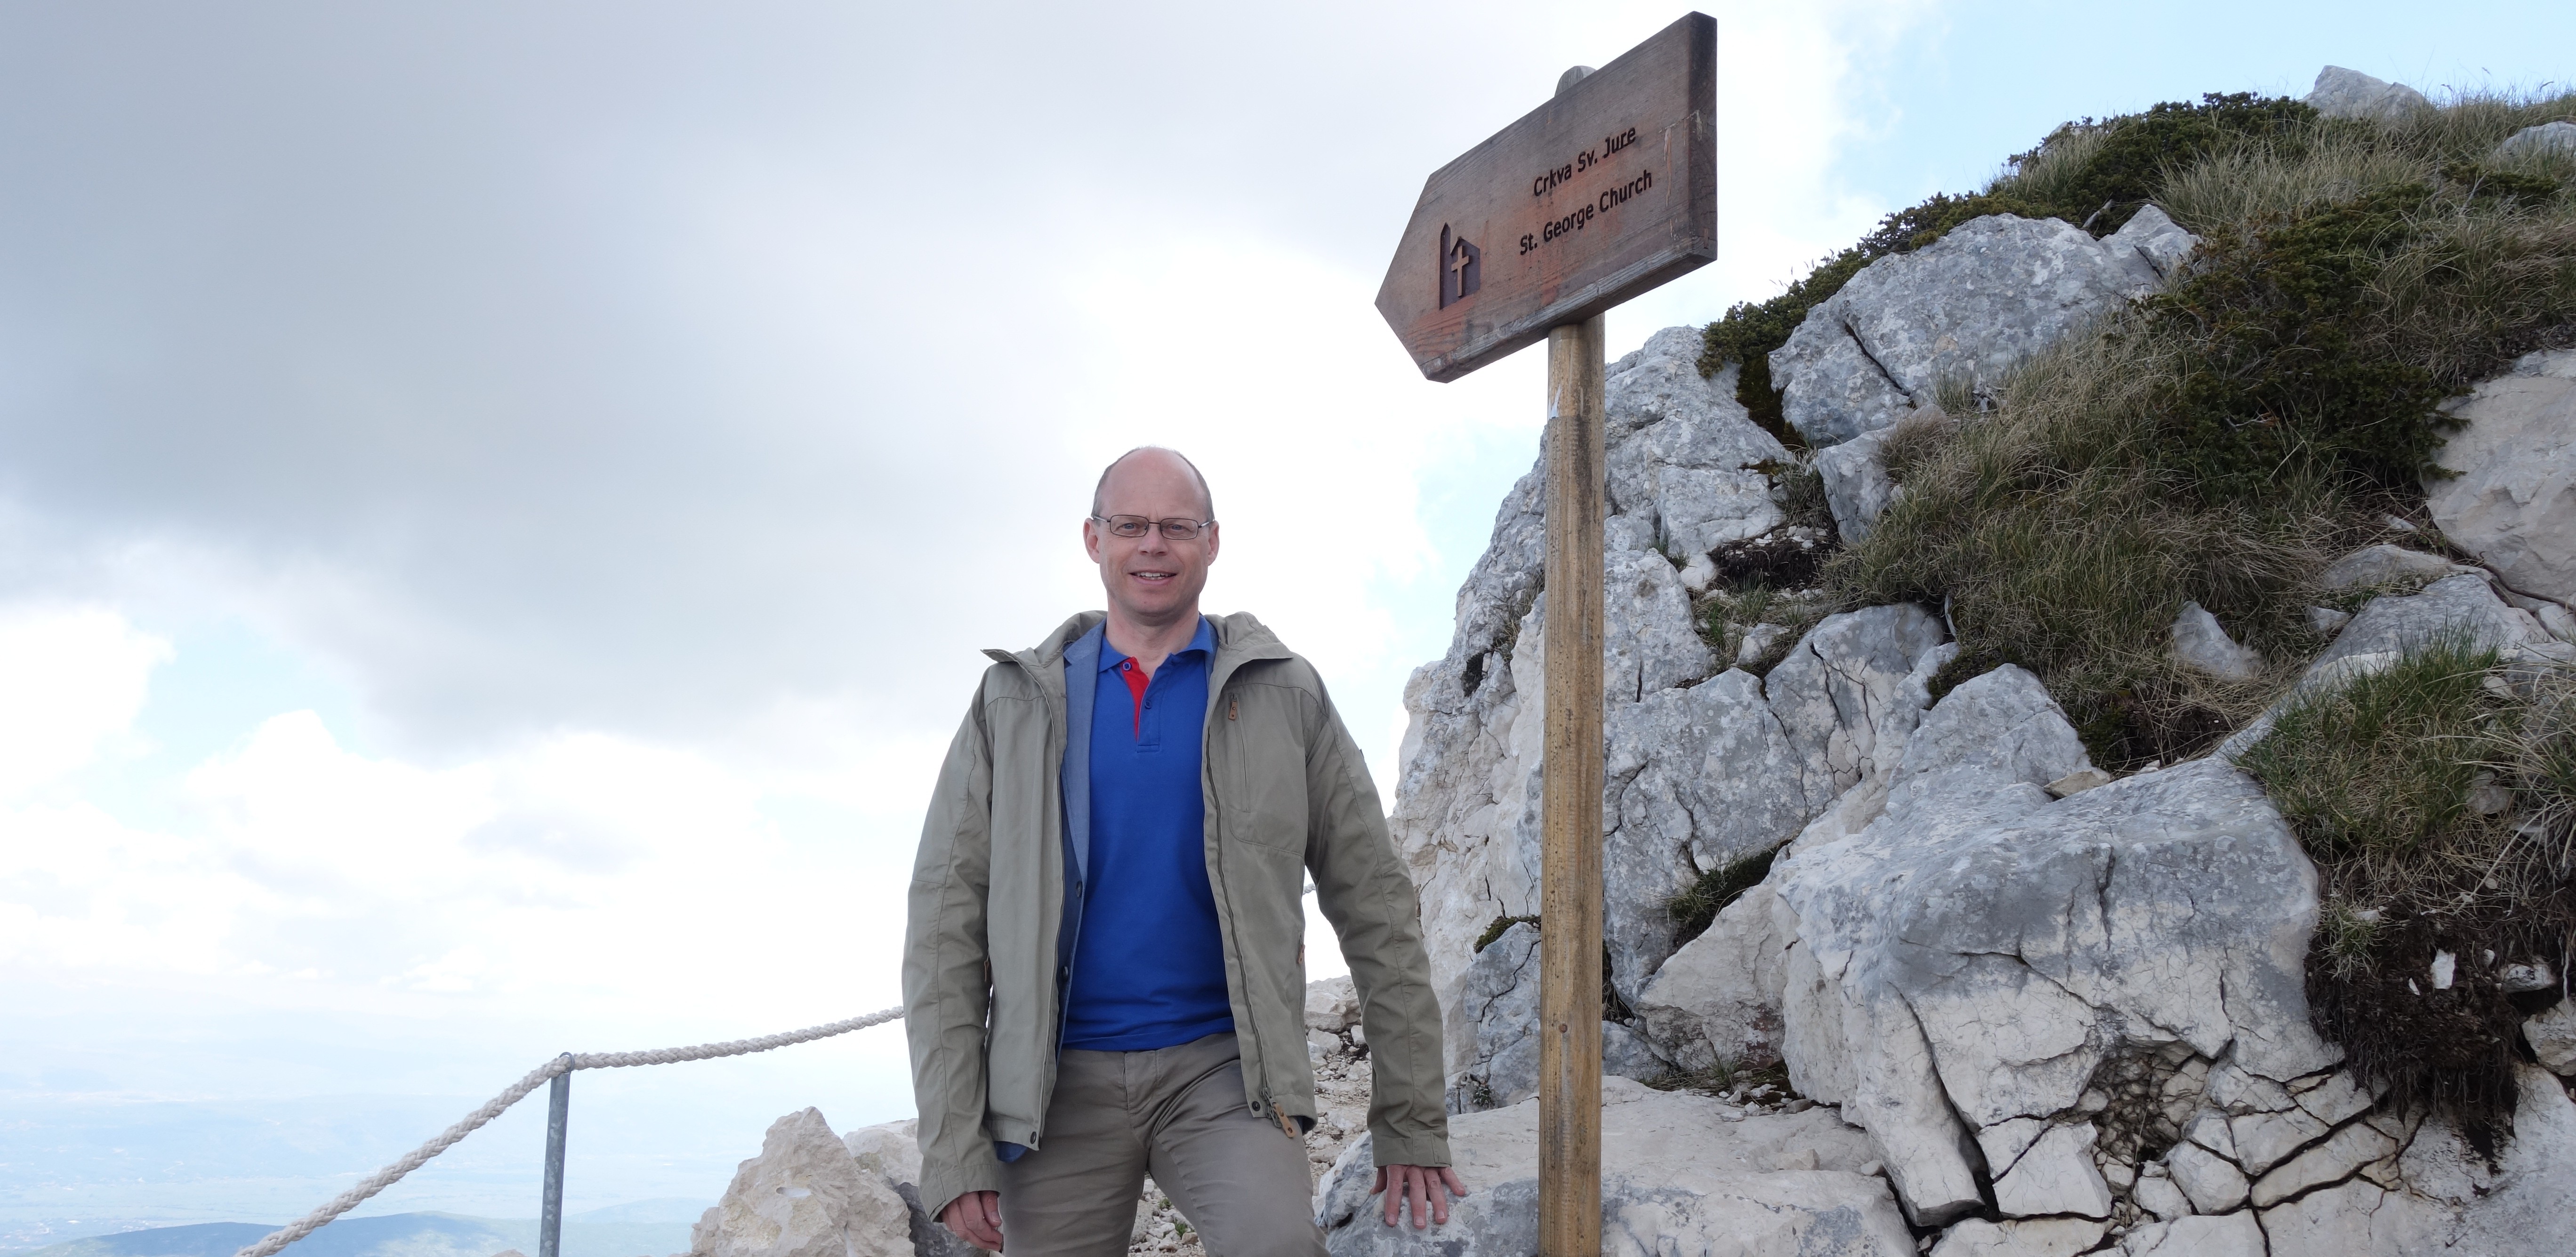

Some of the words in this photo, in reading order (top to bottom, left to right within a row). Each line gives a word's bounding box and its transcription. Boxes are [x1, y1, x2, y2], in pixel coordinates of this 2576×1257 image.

[1534, 164, 1571, 196] Crkva
[1578, 149, 1598, 173] Sv.
[1603, 127, 1636, 158] Jure
[1520, 233, 1538, 255] St.
[1543, 204, 1594, 242] George
[1600, 169, 1652, 212] Church
